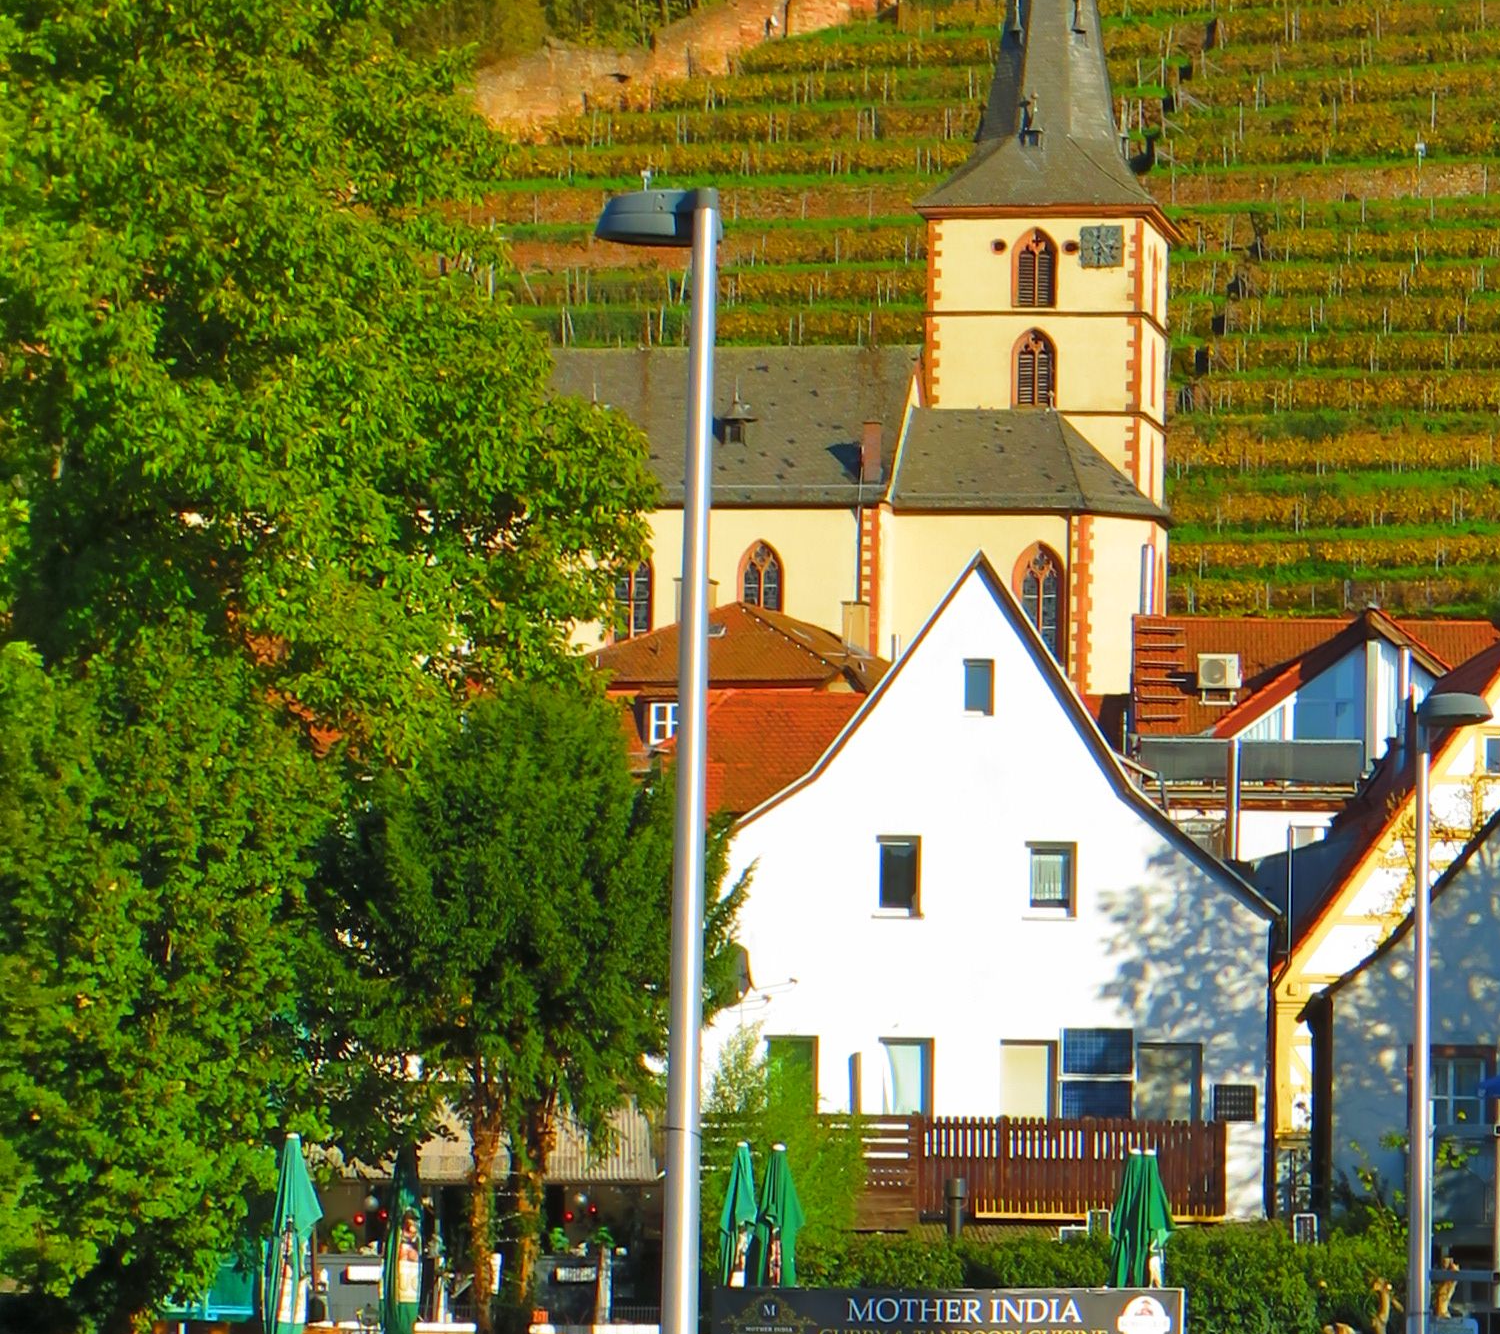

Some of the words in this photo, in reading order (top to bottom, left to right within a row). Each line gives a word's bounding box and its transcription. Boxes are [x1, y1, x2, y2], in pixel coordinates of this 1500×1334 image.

[763, 1304, 776, 1316] M
[846, 1297, 982, 1323] MOTHER
[989, 1298, 1082, 1323] INDIA
